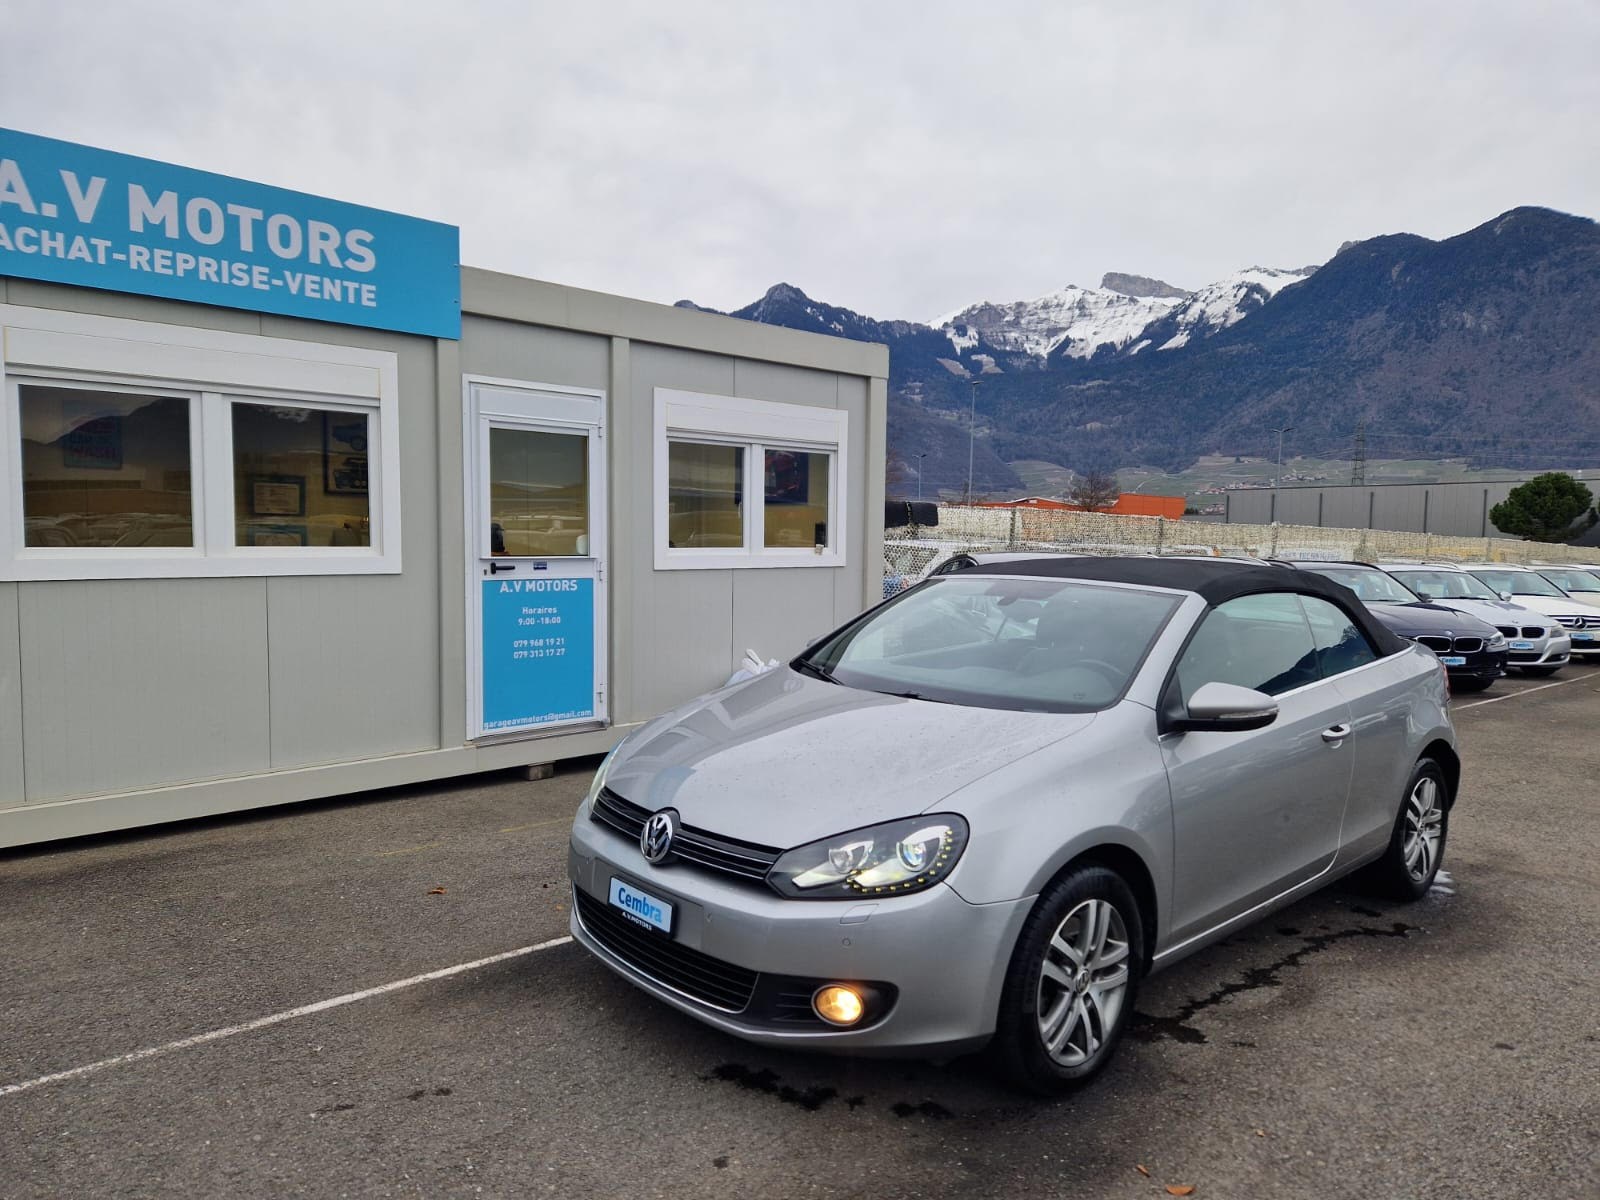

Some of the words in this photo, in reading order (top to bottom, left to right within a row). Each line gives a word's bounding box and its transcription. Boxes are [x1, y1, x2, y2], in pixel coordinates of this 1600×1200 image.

[0, 158, 107, 223] A.V
[128, 183, 376, 272] MOTORS
[500, 581, 522, 593] A.V
[525, 579, 578, 592] MOTORS
[522, 606, 558, 614] Horaires
[513, 639, 528, 648] 079
[545, 638, 554, 646] 19
[556, 637, 565, 646] 21
[513, 650, 528, 659] 079
[555, 647, 566, 656] 27
[618, 886, 663, 923] Cembra
